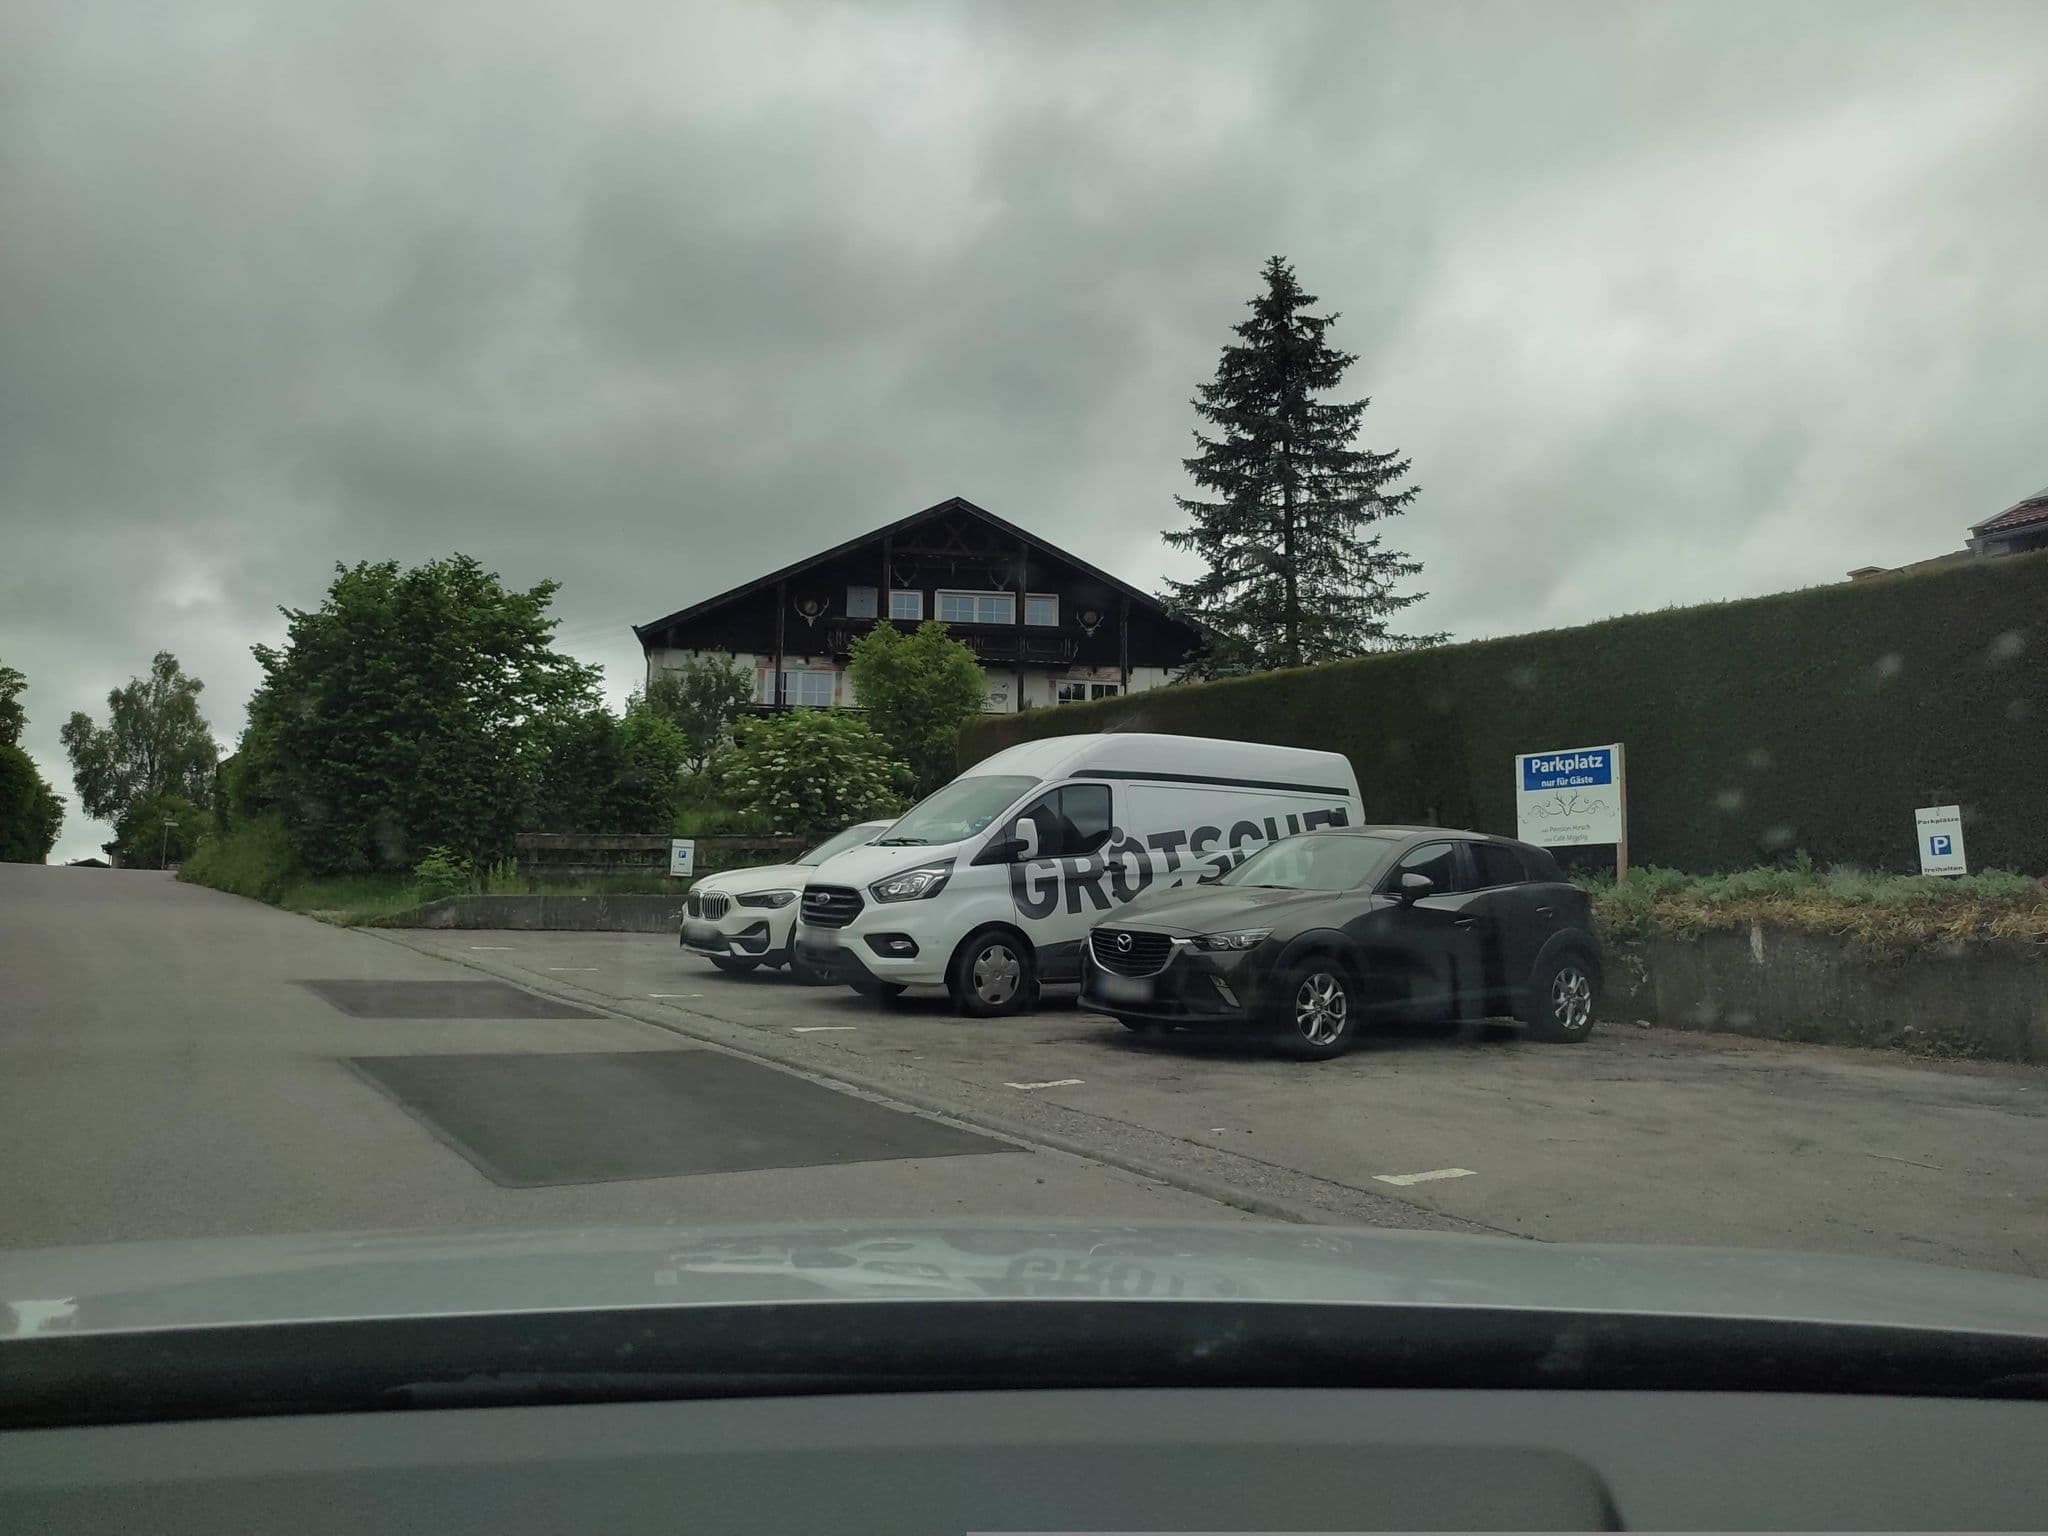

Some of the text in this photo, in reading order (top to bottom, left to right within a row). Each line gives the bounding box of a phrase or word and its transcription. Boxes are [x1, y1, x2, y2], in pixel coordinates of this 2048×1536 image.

[1531, 754, 1603, 773] Parkplatz
[1541, 776, 1593, 788] nur für Gäste
[1933, 837, 1949, 855] P
